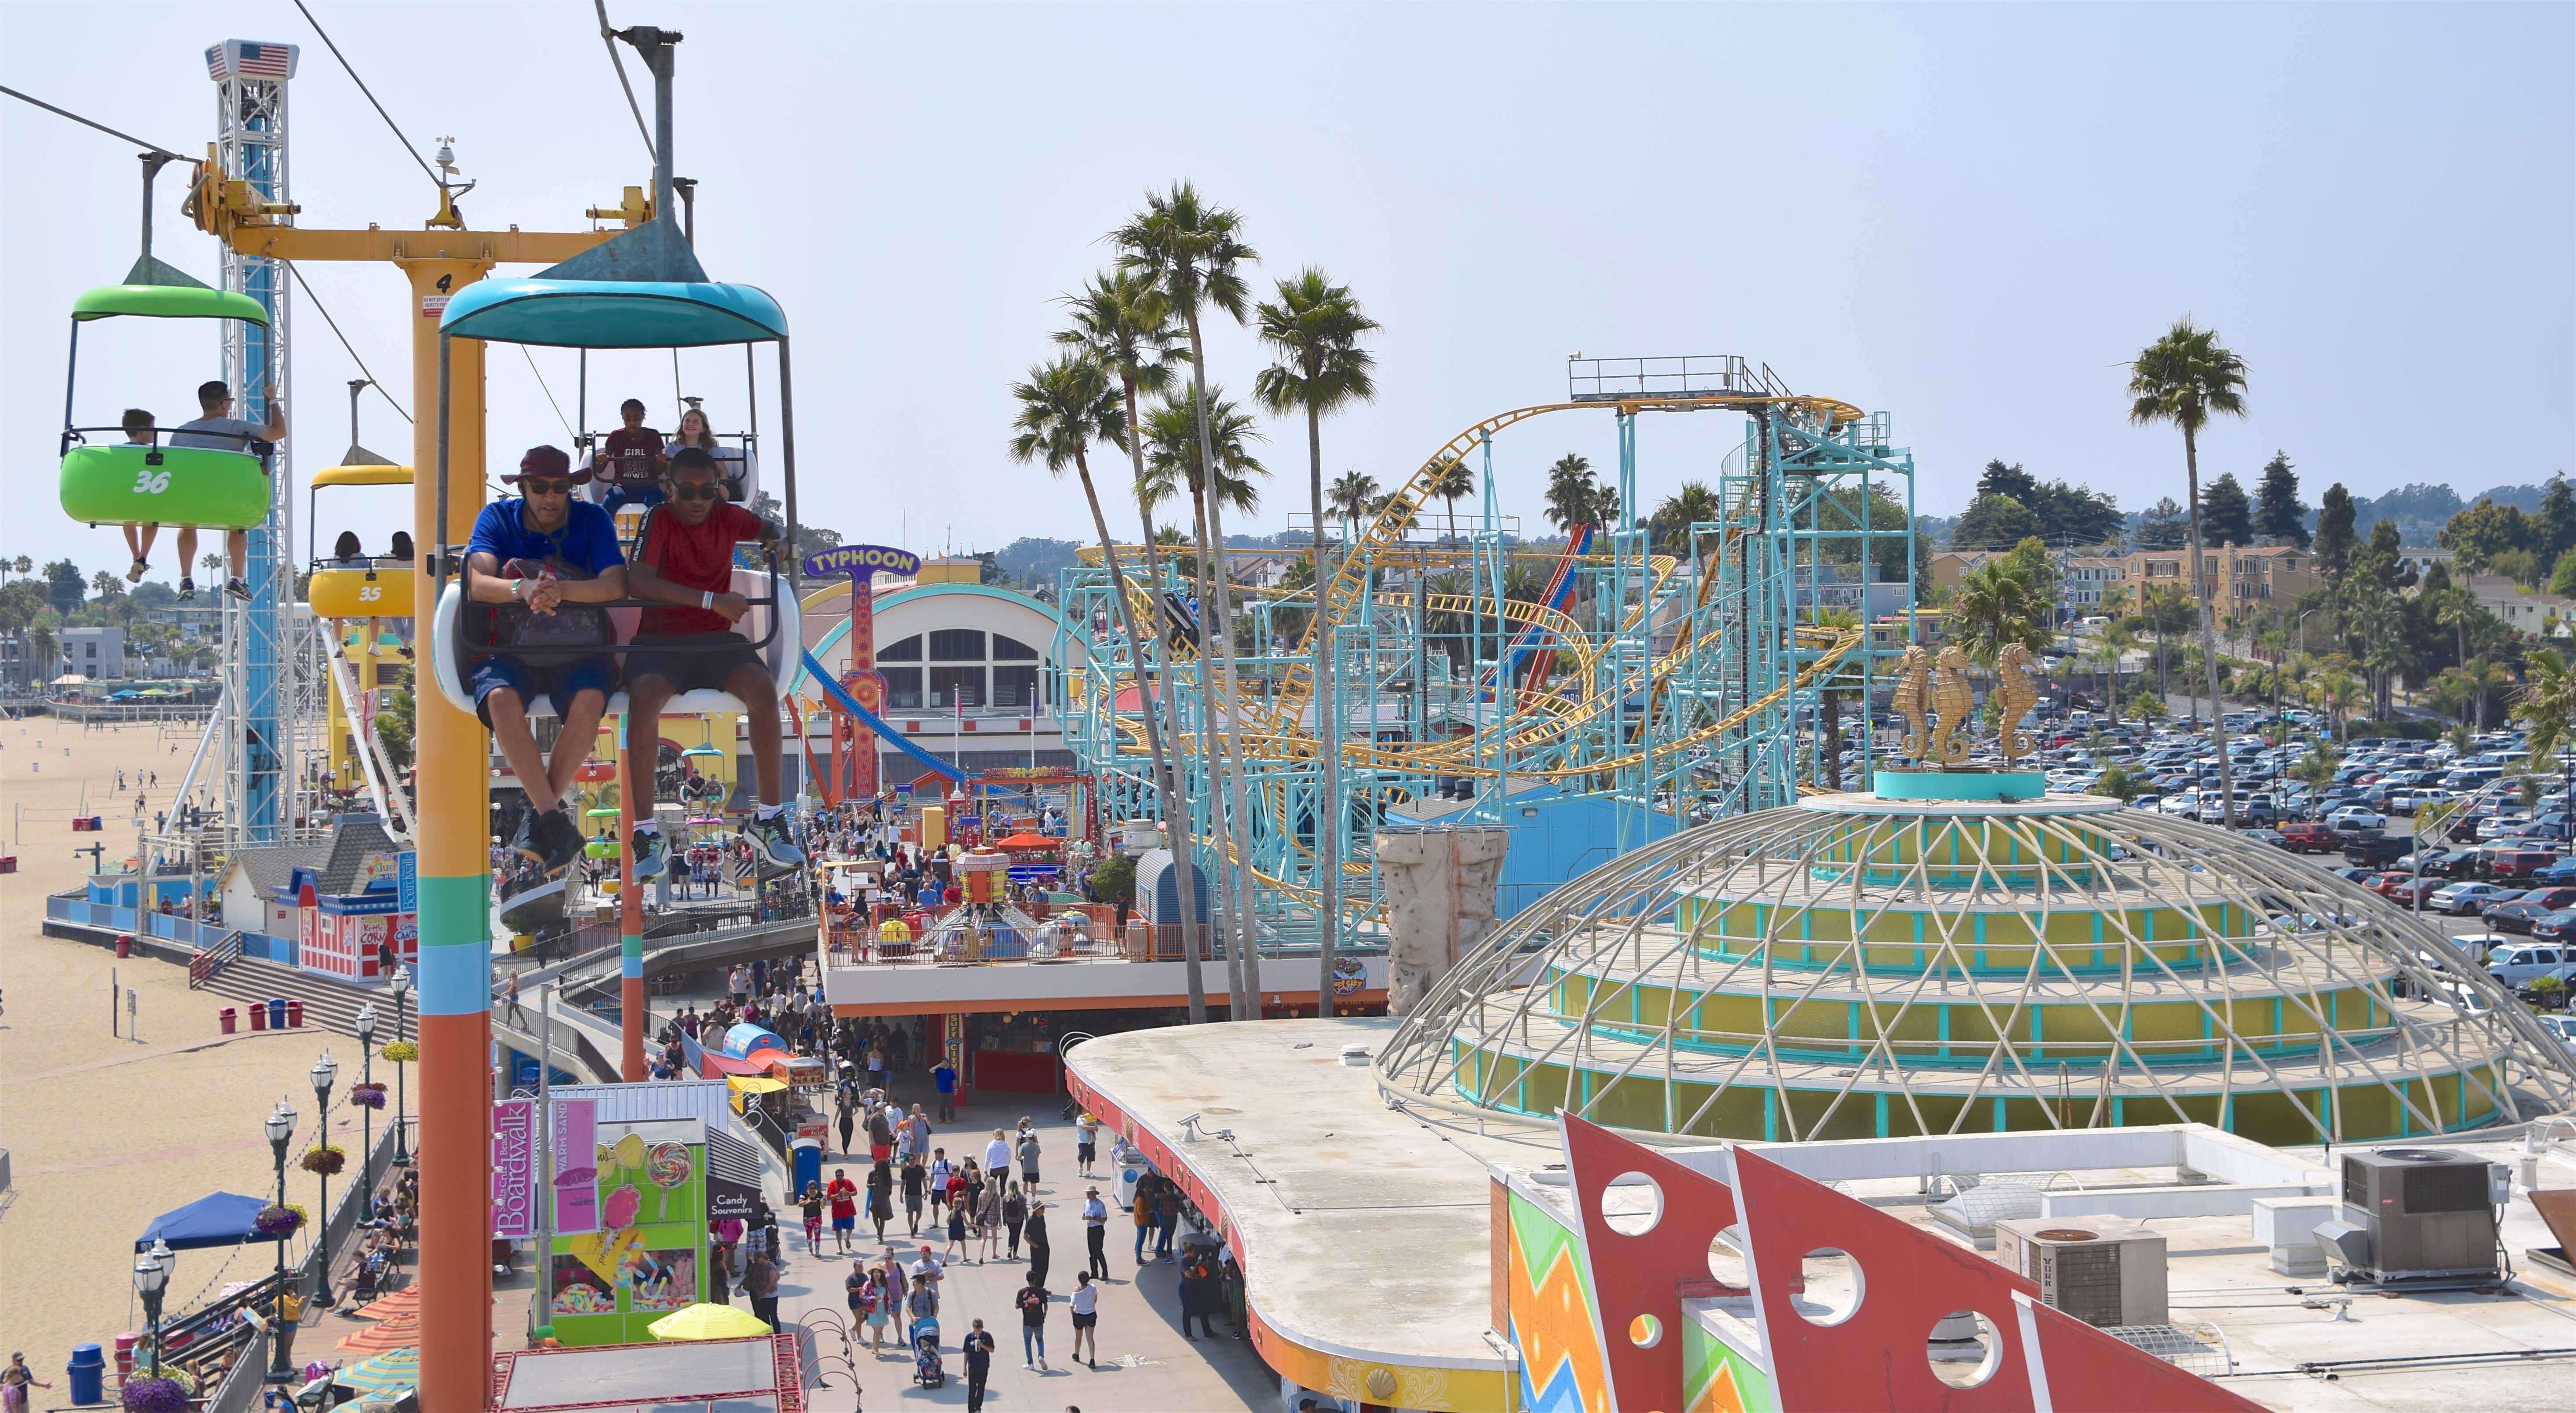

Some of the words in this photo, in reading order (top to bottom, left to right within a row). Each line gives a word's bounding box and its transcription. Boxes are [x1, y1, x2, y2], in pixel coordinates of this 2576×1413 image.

[436, 274, 452, 294] 4
[133, 471, 172, 494] 36
[812, 550, 915, 571] TYPHOON
[359, 586, 382, 601] 35
[984, 767, 1028, 779] BEACH
[403, 854, 415, 911] Boardwalk
[361, 932, 386, 943] CORN
[363, 924, 384, 932] Kettle
[395, 930, 417, 940] CAND
[945, 1037, 963, 1047] Grill
[558, 1103, 567, 1134] SAND
[500, 1131, 508, 1155] Beach
[558, 1137, 567, 1174] WARM
[497, 1103, 527, 1231] Boardwalk
[499, 1166, 507, 1187] Cruz
[711, 1205, 753, 1215] Souvenirs
[716, 1193, 748, 1208] Candy
[2043, 1257, 2053, 1287] YORK
